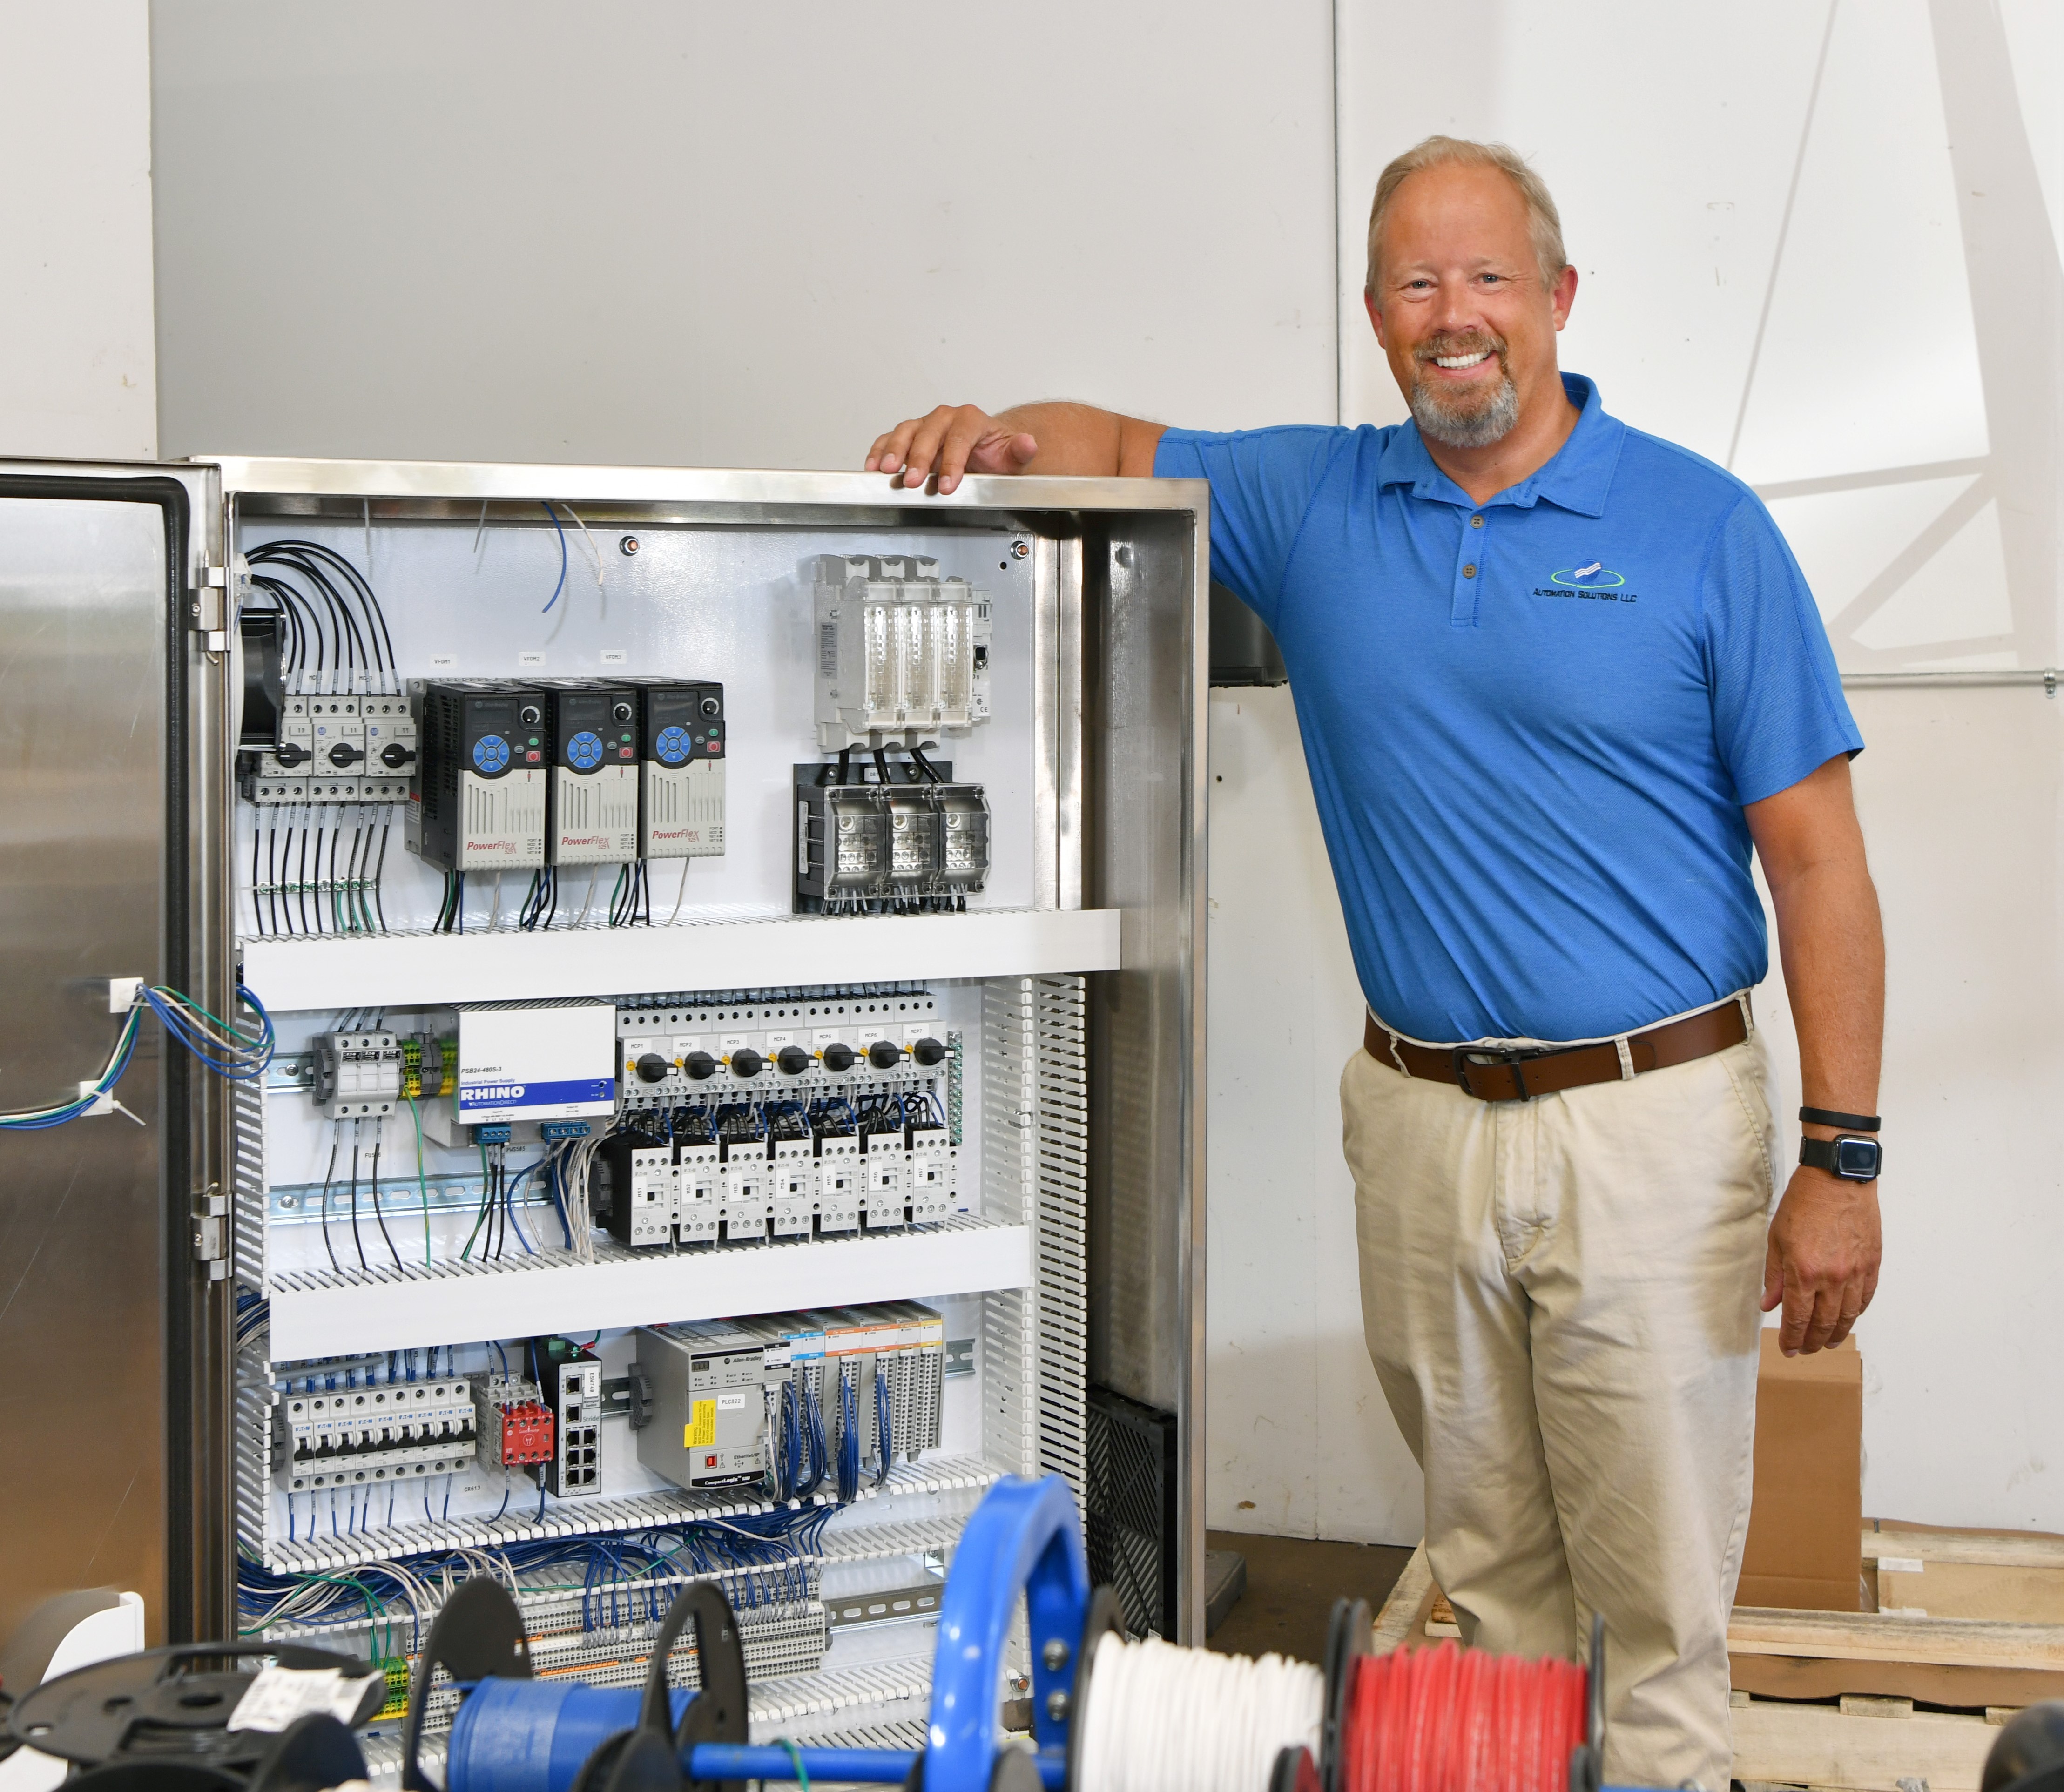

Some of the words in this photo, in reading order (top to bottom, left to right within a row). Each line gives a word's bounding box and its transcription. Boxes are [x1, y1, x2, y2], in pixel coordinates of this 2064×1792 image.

[1532, 588, 1575, 598] AUTOMATION
[1578, 590, 1617, 601] SOLUTIONS
[1620, 593, 1637, 602] LLC
[652, 829, 699, 842] PowerFlex
[467, 841, 516, 854] PowerFlex
[561, 836, 610, 849] PowerFlex
[460, 1086, 525, 1101] RHINO
